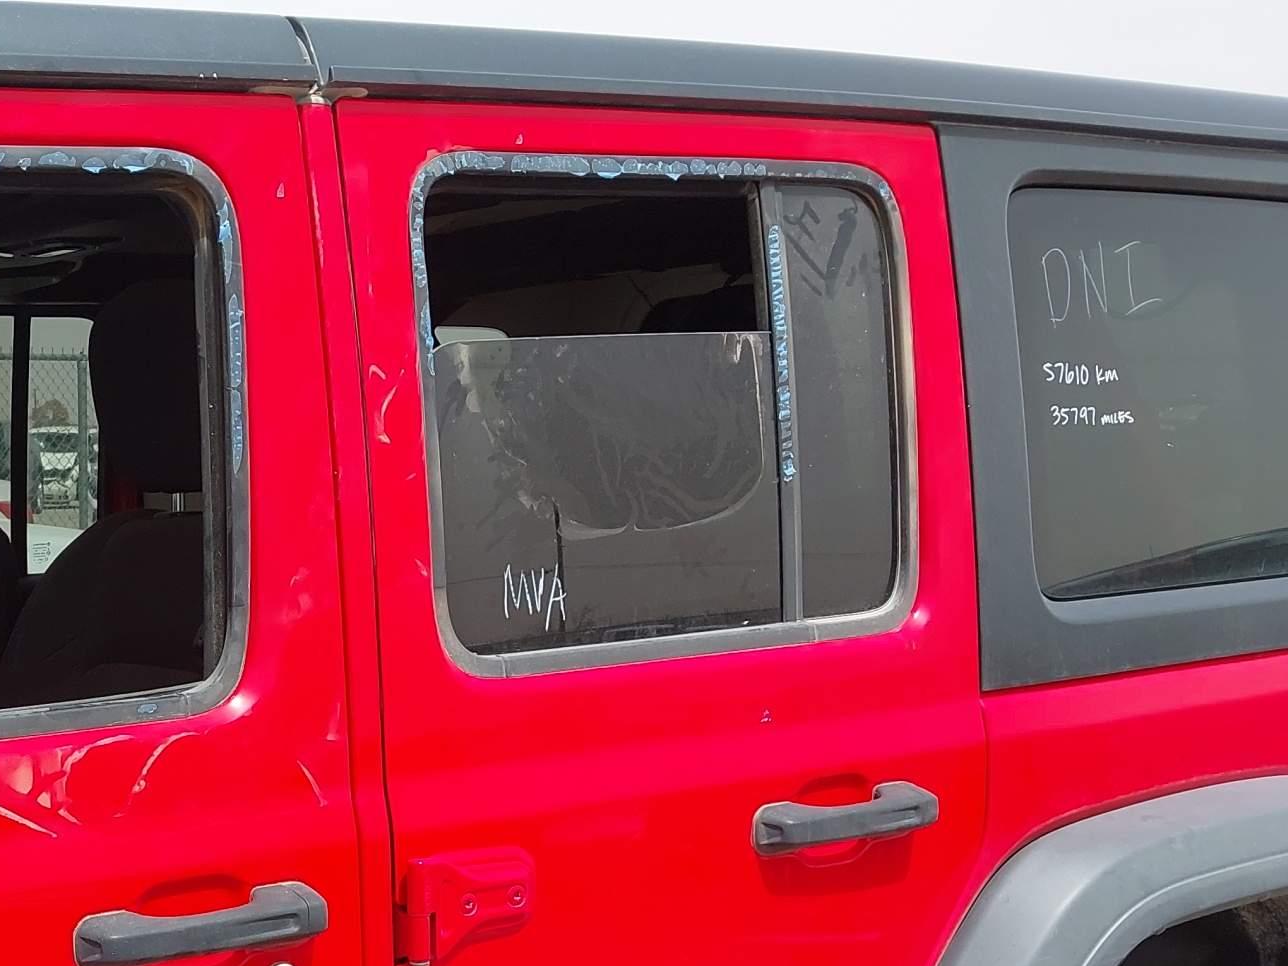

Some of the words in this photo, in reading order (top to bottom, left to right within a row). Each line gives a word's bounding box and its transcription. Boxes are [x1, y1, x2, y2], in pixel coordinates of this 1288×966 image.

[1041, 240, 1163, 328] DNI
[1042, 362, 1089, 385] 57610
[1050, 405, 1096, 426] 35797
[503, 562, 567, 631] MVA
